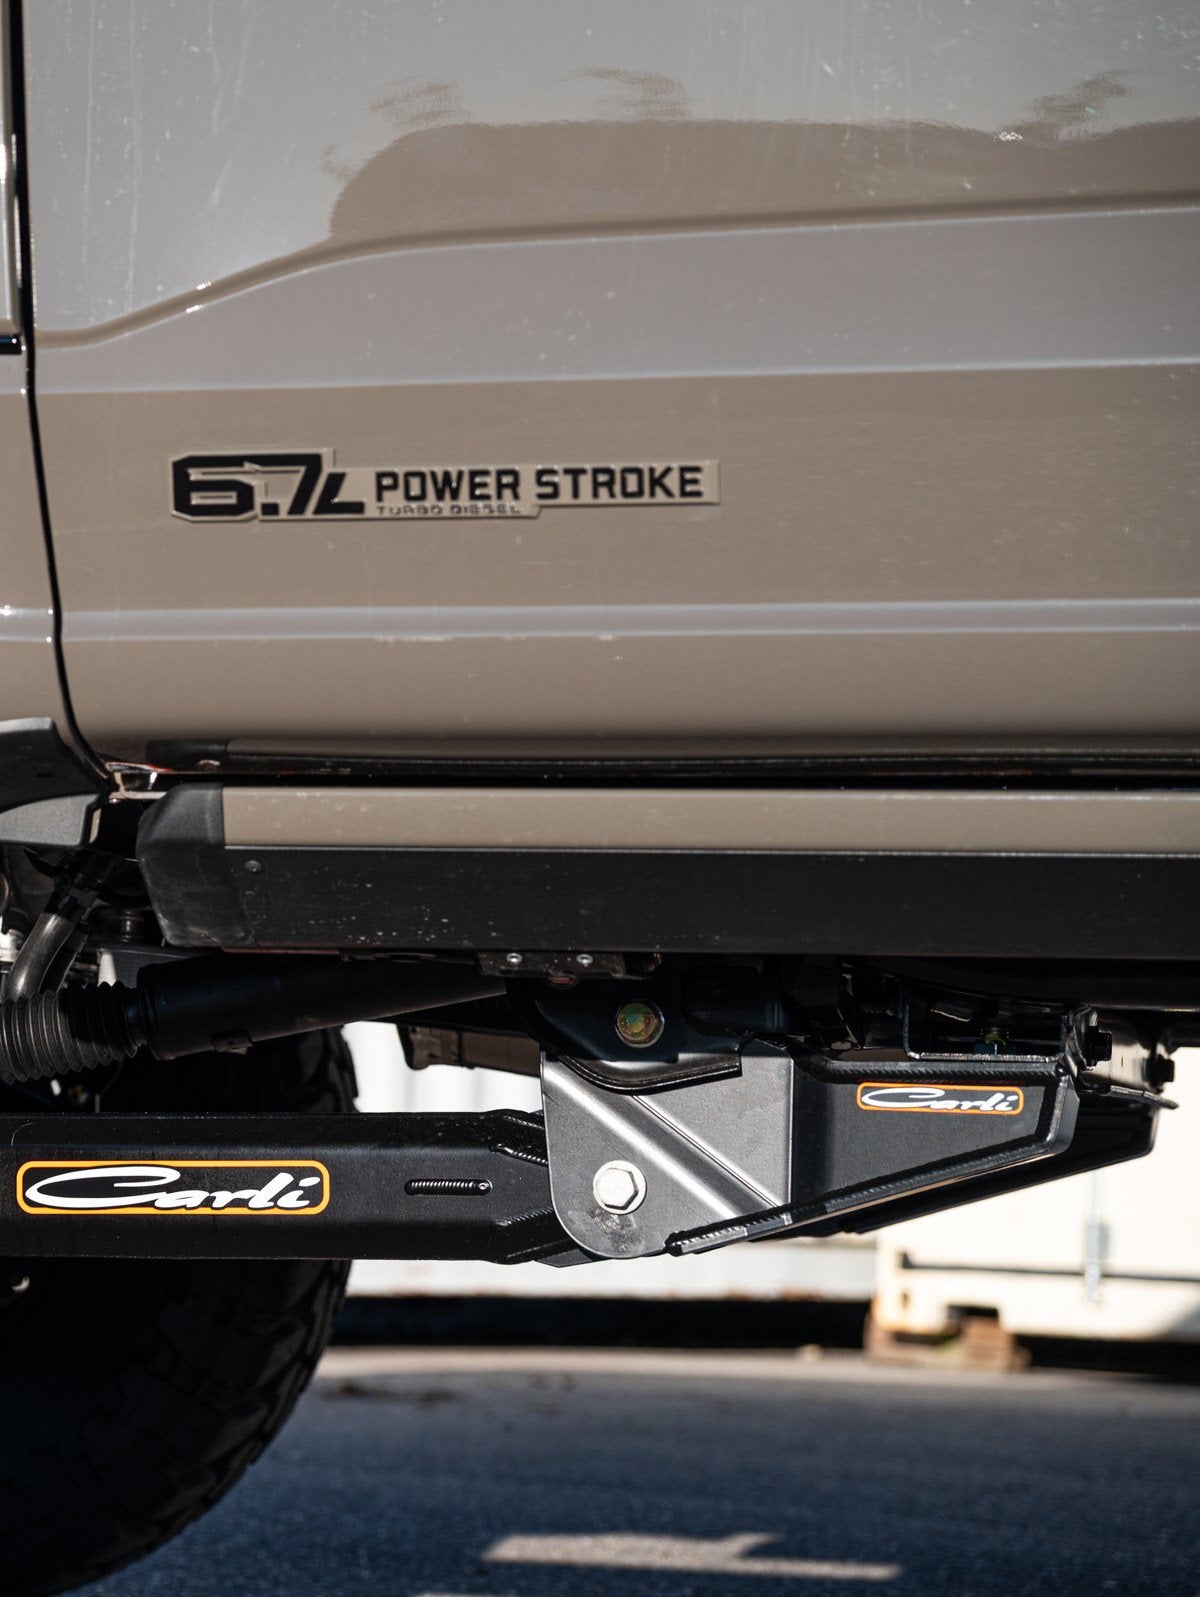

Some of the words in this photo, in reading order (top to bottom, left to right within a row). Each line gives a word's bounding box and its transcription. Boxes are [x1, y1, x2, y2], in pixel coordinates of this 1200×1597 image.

[173, 453, 366, 516] 6.7L
[375, 469, 520, 502] POWER
[535, 466, 703, 500] STROKE
[376, 503, 443, 515] TURBO
[450, 502, 522, 515] DIESEL
[861, 1087, 1018, 1111] Carli
[25, 1165, 321, 1209] Carli
